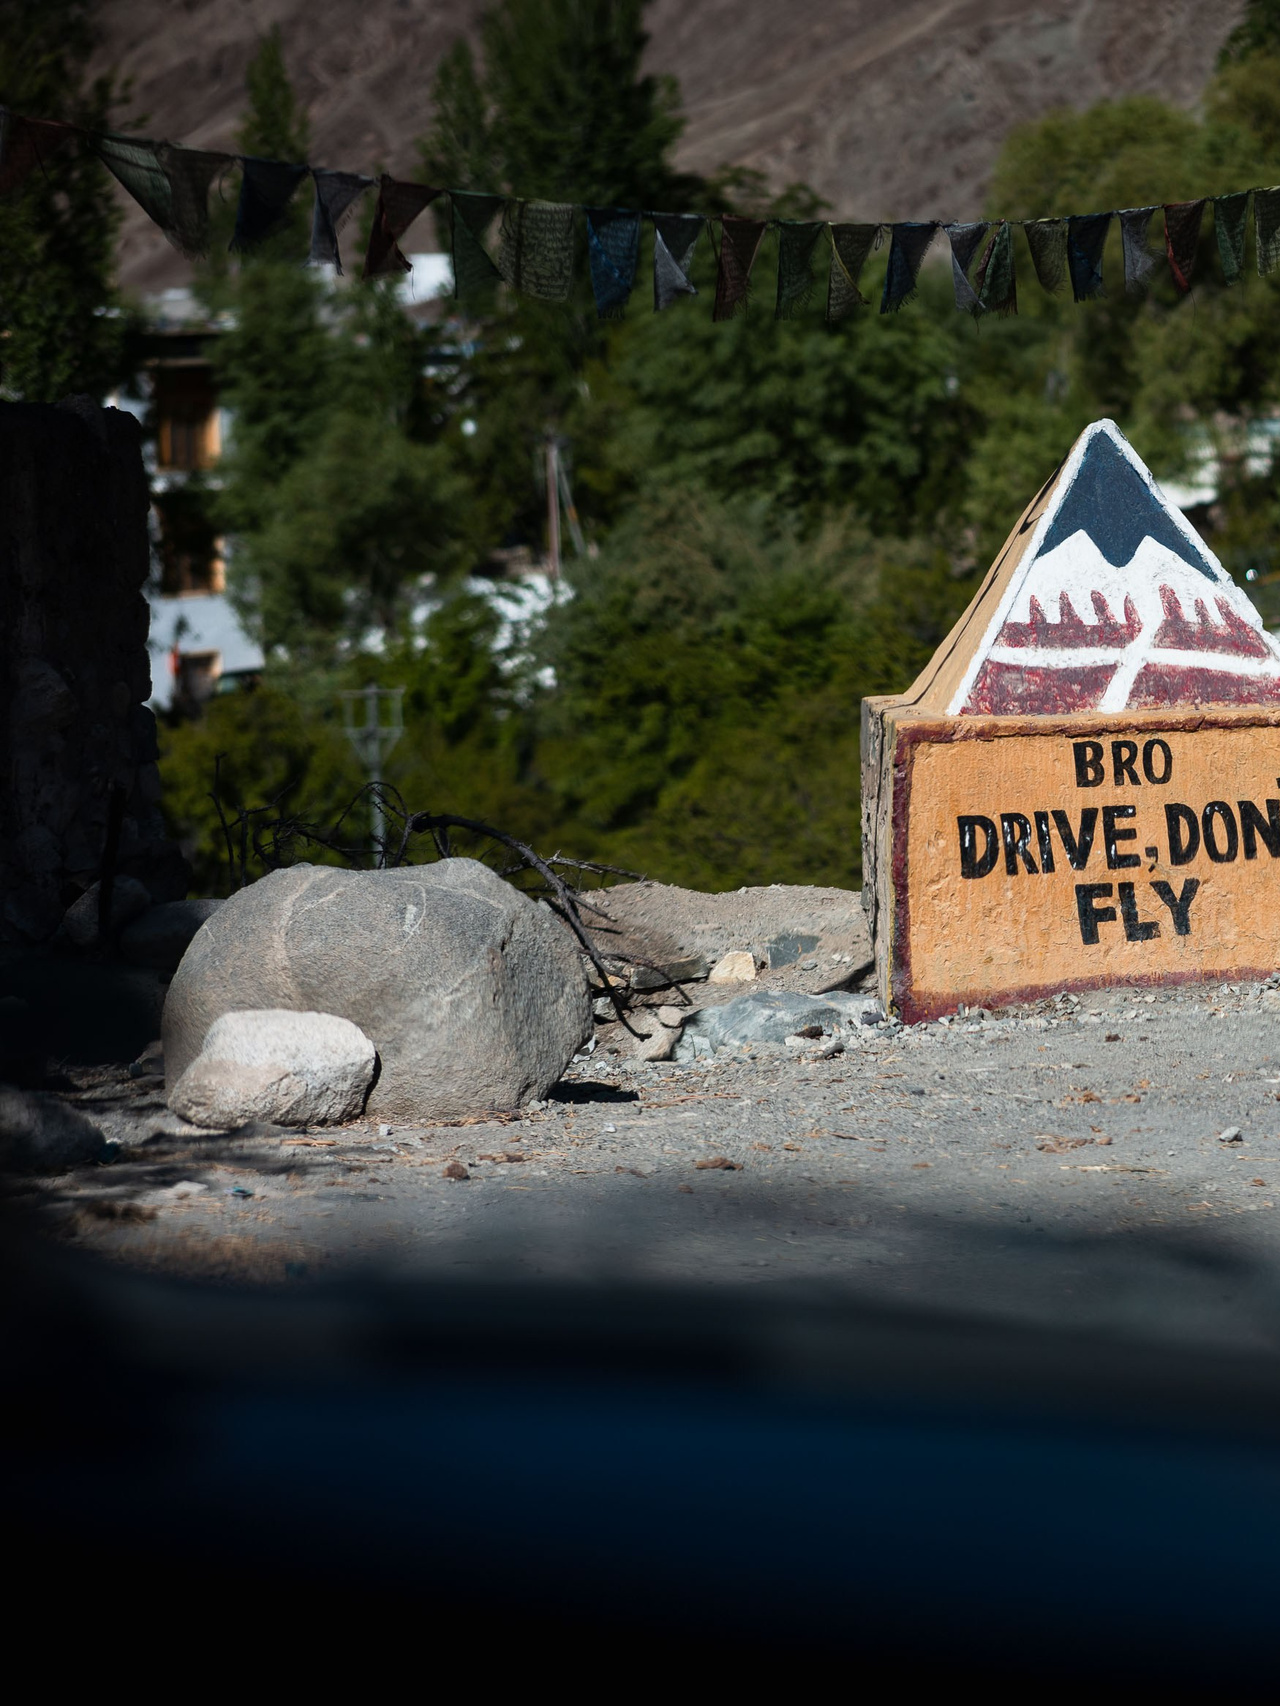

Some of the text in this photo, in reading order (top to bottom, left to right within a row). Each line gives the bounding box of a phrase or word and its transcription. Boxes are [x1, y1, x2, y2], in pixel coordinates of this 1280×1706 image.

[1073, 739, 1173, 787] BRO
[957, 805, 1158, 879] DRIVE,
[1075, 878, 1200, 945] FLY
